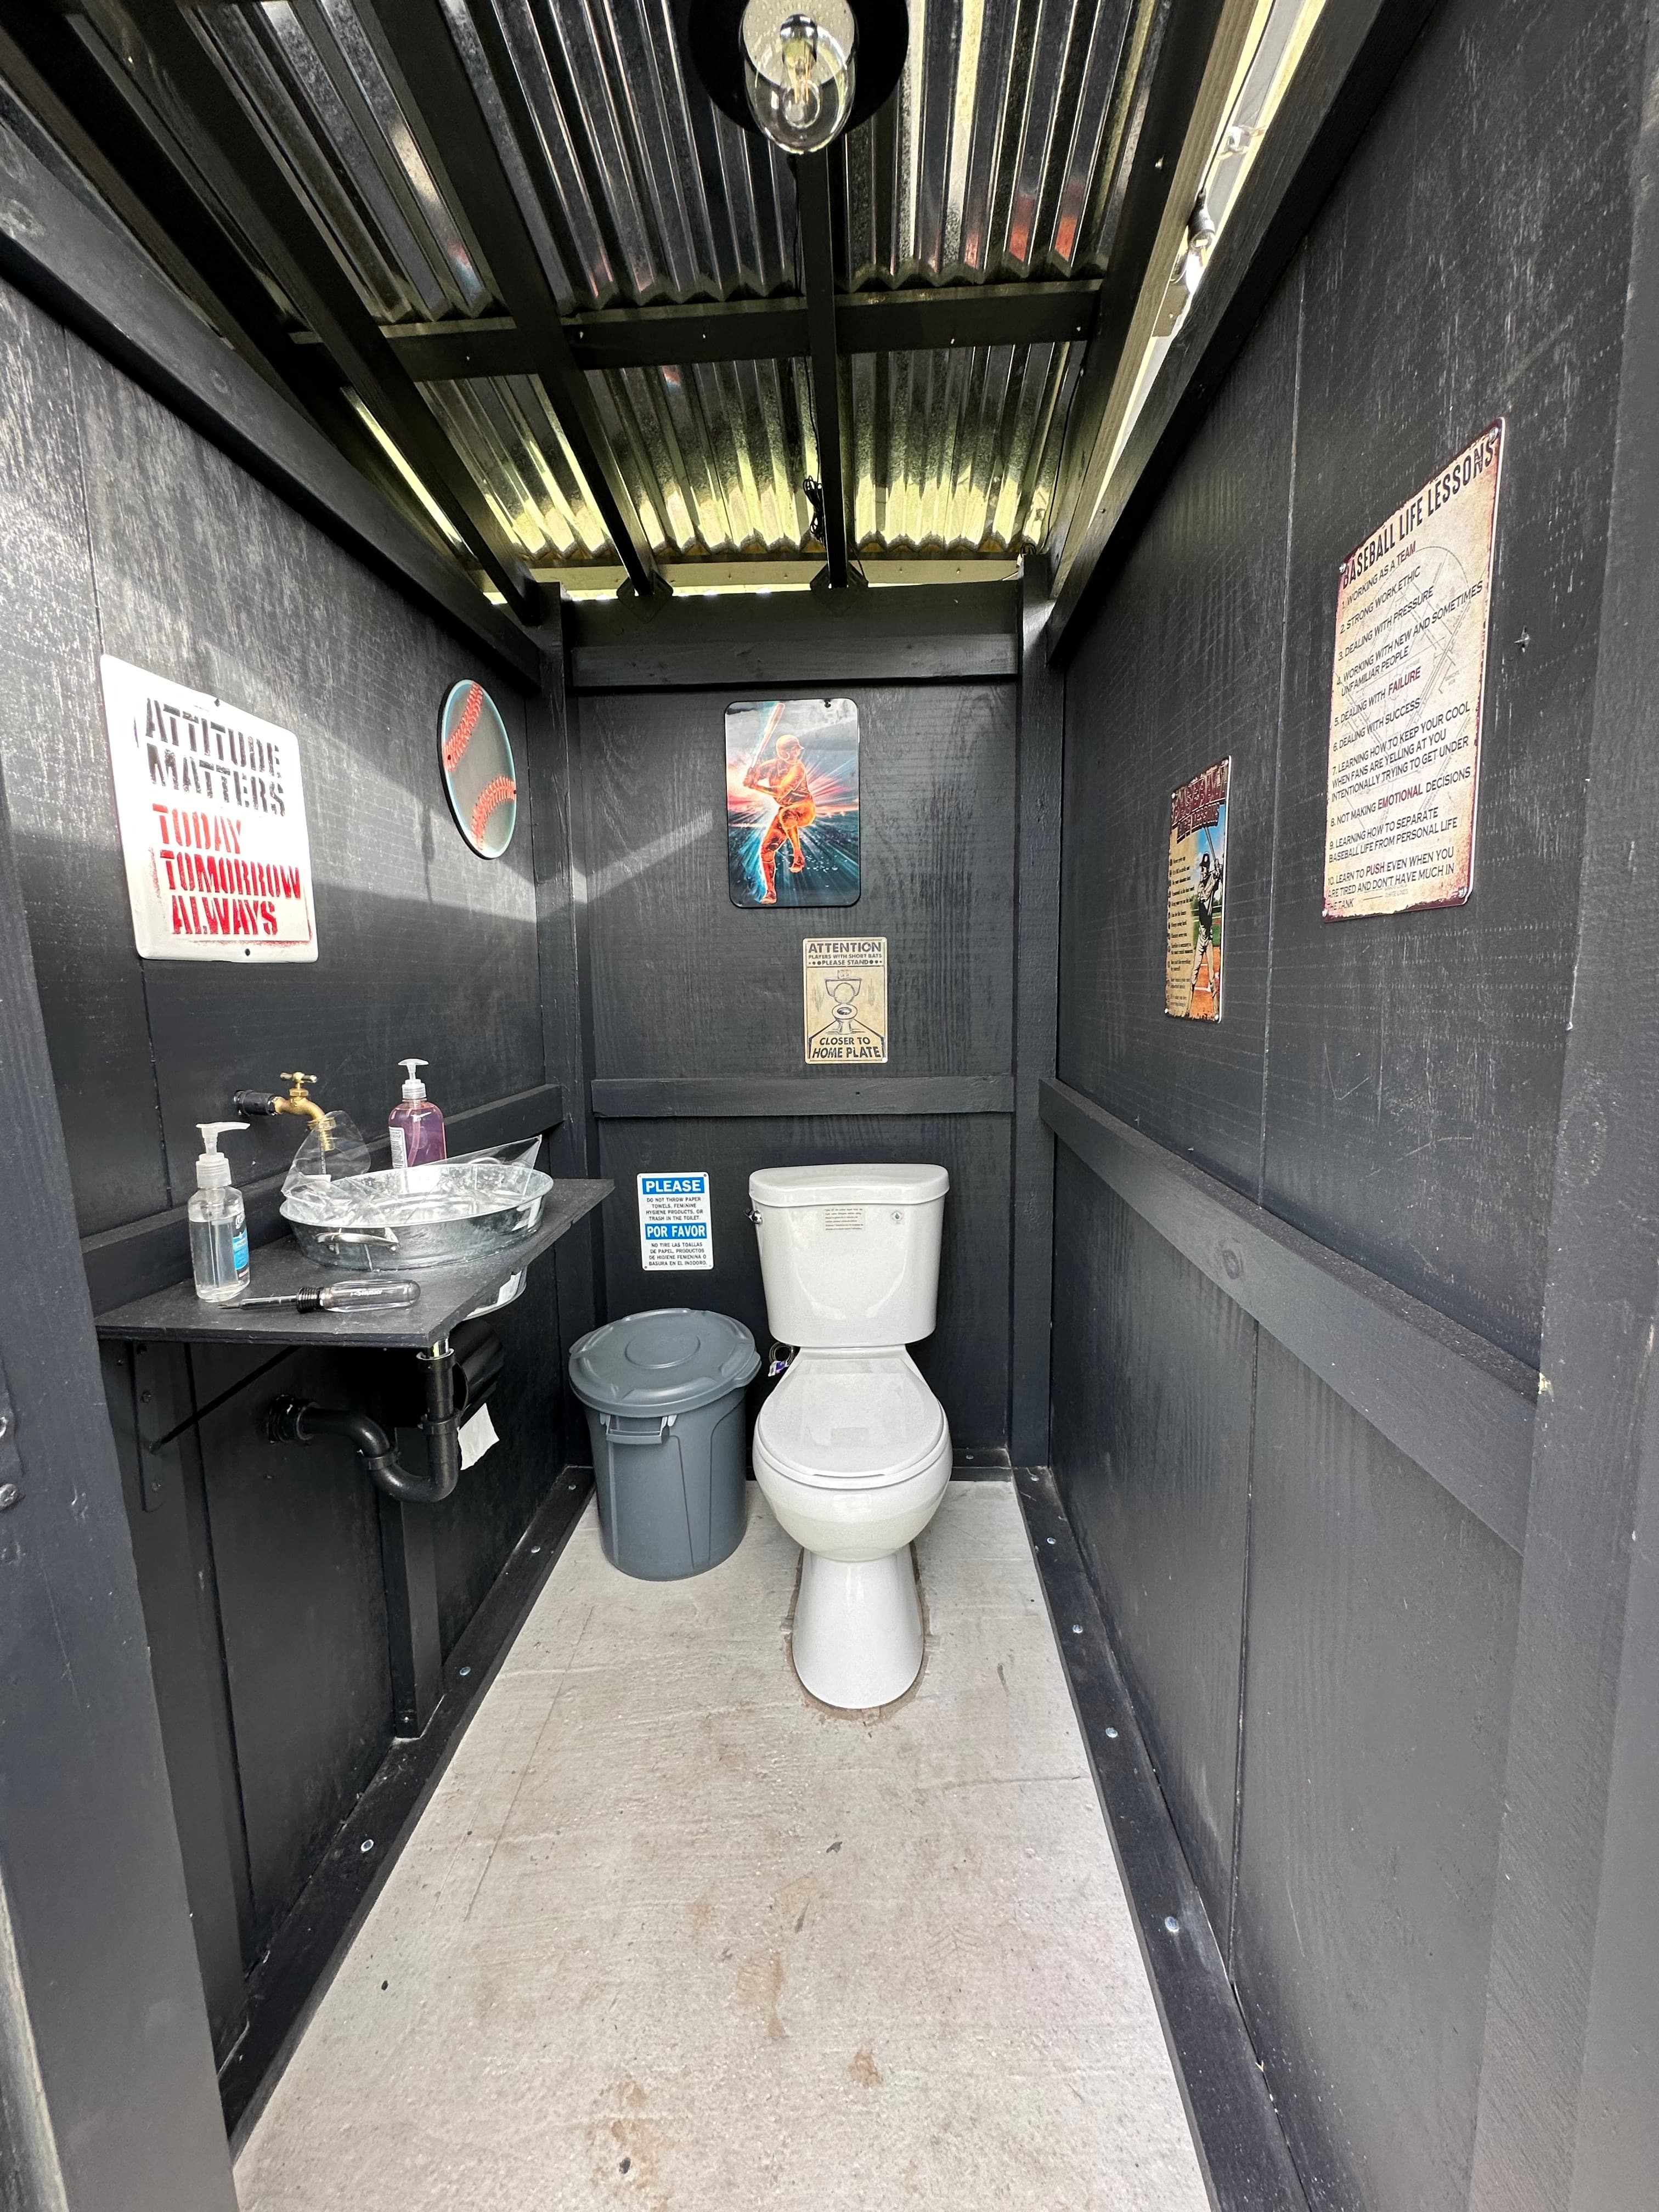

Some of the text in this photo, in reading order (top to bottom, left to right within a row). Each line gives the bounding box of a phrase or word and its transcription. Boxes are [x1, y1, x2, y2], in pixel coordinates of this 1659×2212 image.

[1343, 442, 1494, 590] BASEBALL LIFE LESSONS
[1340, 566, 1420, 634] 2. STRONG WORK ETHIC
[1347, 574, 1378, 606] WORKING
[1379, 565, 1389, 580] AS
[1390, 560, 1395, 572] A
[1396, 540, 1415, 566] TEAM
[1338, 585, 1434, 661] 3. DEALING WITH PRESSURE
[1344, 654, 1374, 682] WORKING
[1375, 641, 1393, 661] WITH
[1394, 628, 1412, 649] NEW
[1413, 617, 1430, 636] AND
[1431, 580, 1483, 624] SOMETIMES
[1334, 717, 1339, 726] 5.
[1341, 700, 1367, 723] DEALING
[1369, 689, 1386, 707] WITH
[1388, 666, 1421, 696] FAILURE
[1341, 645, 1409, 697] UNFAMILIAR PEOPLE
[146, 698, 282, 778] ATTITUDE
[1333, 698, 1420, 752] 6. DEALING WITH SUCCESS
[1333, 701, 1470, 775] 7. LEARNING HOW TO KEEP YOUR COOL
[147, 743, 285, 816] MATTERS
[1331, 736, 1469, 803] INTENTIONALLY TRYING TO GET UNDER
[1333, 729, 1446, 788] WHEN FANS ARE YELLING AT YOU
[1331, 818, 1335, 827] 8.
[1337, 812, 1350, 825] NOT
[1351, 802, 1376, 820] MAKING
[1378, 784, 1423, 810] EMOTIONAL
[1426, 766, 1470, 793] DECISIONS
[152, 803, 241, 854] TODAY
[1329, 806, 1438, 850] 9. LEARNING HOW TO SEPARATE
[1329, 817, 1458, 864] BASEBALL LIFE FROM PERSONAL LIFE
[160, 850, 301, 900] TOMORROW
[1336, 871, 1355, 884] LEARN
[1356, 869, 1364, 879] TO
[1366, 862, 1385, 876] PUSH
[1387, 858, 1407, 872] EVEN
[1409, 851, 1433, 867] WHEN
[1435, 846, 1454, 861] YOU
[1340, 884, 1356, 896] TIRED
[1357, 881, 1371, 893] AND
[1373, 876, 1394, 889] DON'T
[1395, 871, 1417, 885] HAVE
[1418, 865, 1444, 880] MUCH
[1445, 863, 1454, 874] IN
[172, 895, 279, 935] ALWAYS
[809, 943, 881, 953] ATTENTION
[812, 1047, 881, 1058] HOME PLATE
[646, 1180, 701, 1192] PLEASE
[647, 1225, 706, 1238] POR FAVOR
